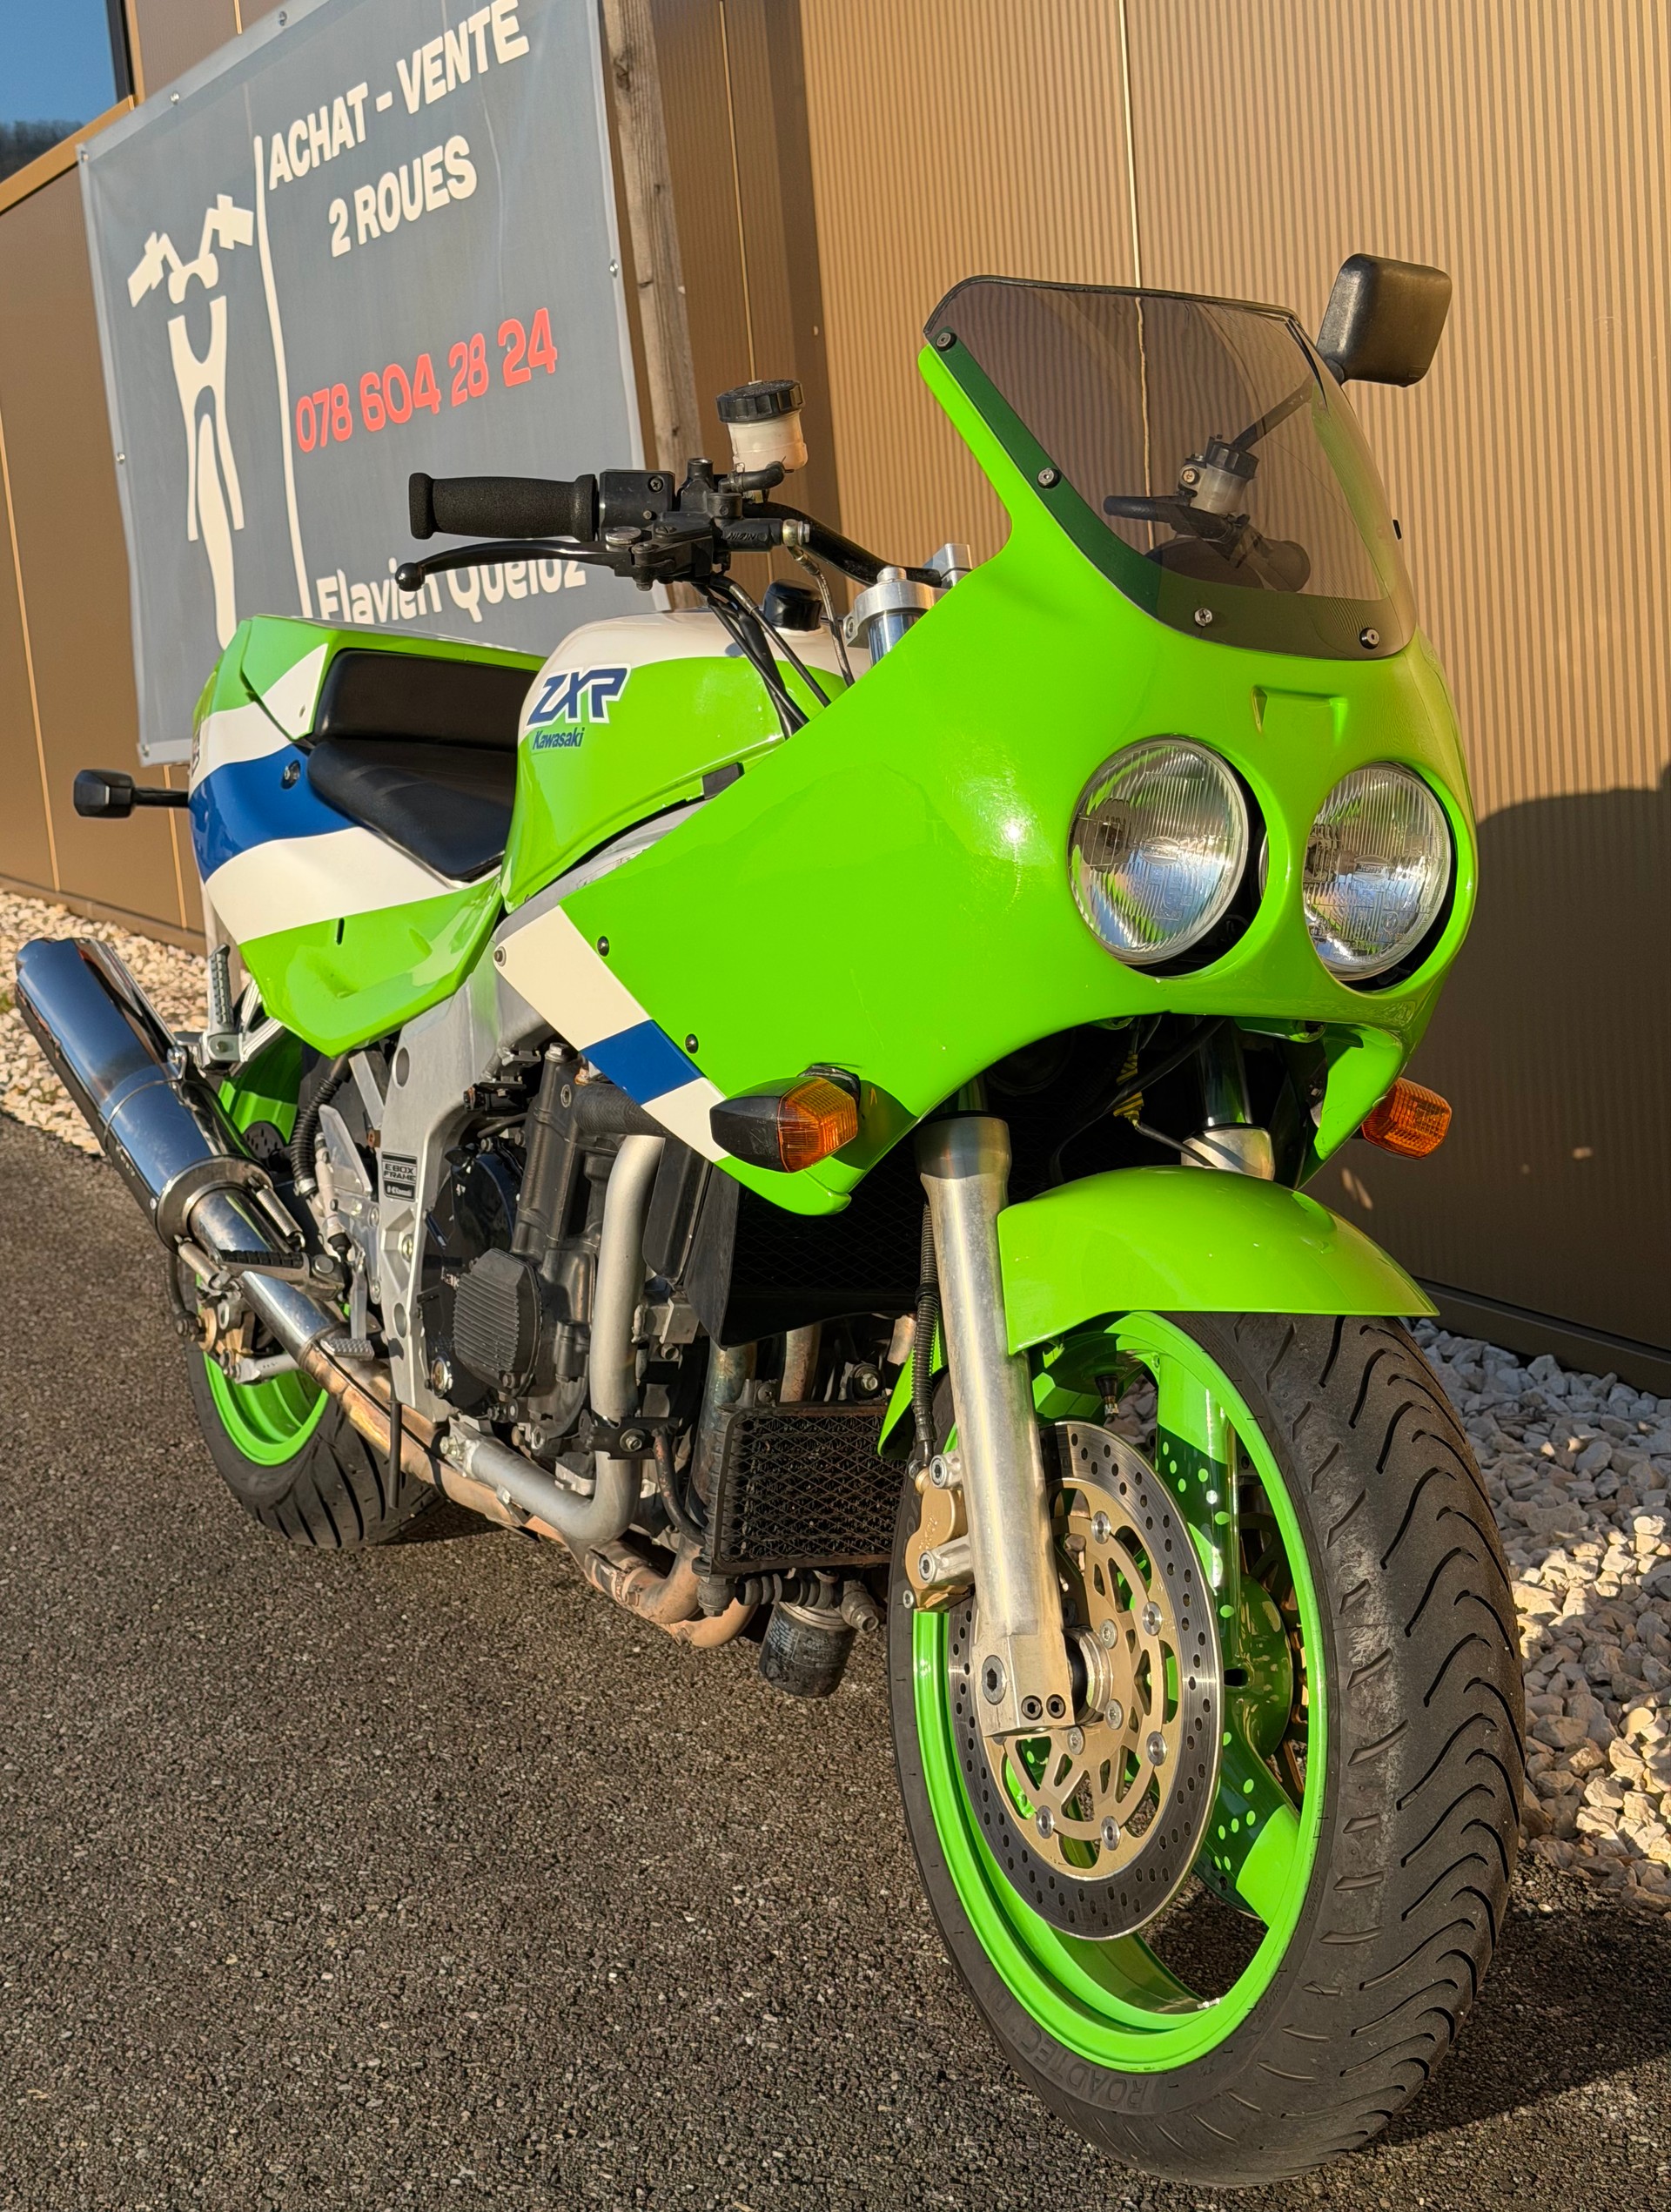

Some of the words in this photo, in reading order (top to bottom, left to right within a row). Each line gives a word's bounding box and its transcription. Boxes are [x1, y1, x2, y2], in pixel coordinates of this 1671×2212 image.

[269, 82, 369, 191] ACHAT
[376, 91, 393, 112] -
[396, 0, 530, 114] VENTE
[329, 198, 352, 258] 2
[354, 135, 478, 245] ROUES
[296, 383, 352, 453] 078
[359, 353, 442, 432] 604
[449, 333, 490, 407] 28
[498, 307, 558, 387] 24
[316, 557, 443, 624] Flavien
[532, 727, 586, 750] Kawasaki
[383, 1170, 417, 1181] FRAME
[1020, 2024, 1150, 2109] ROADTEC
